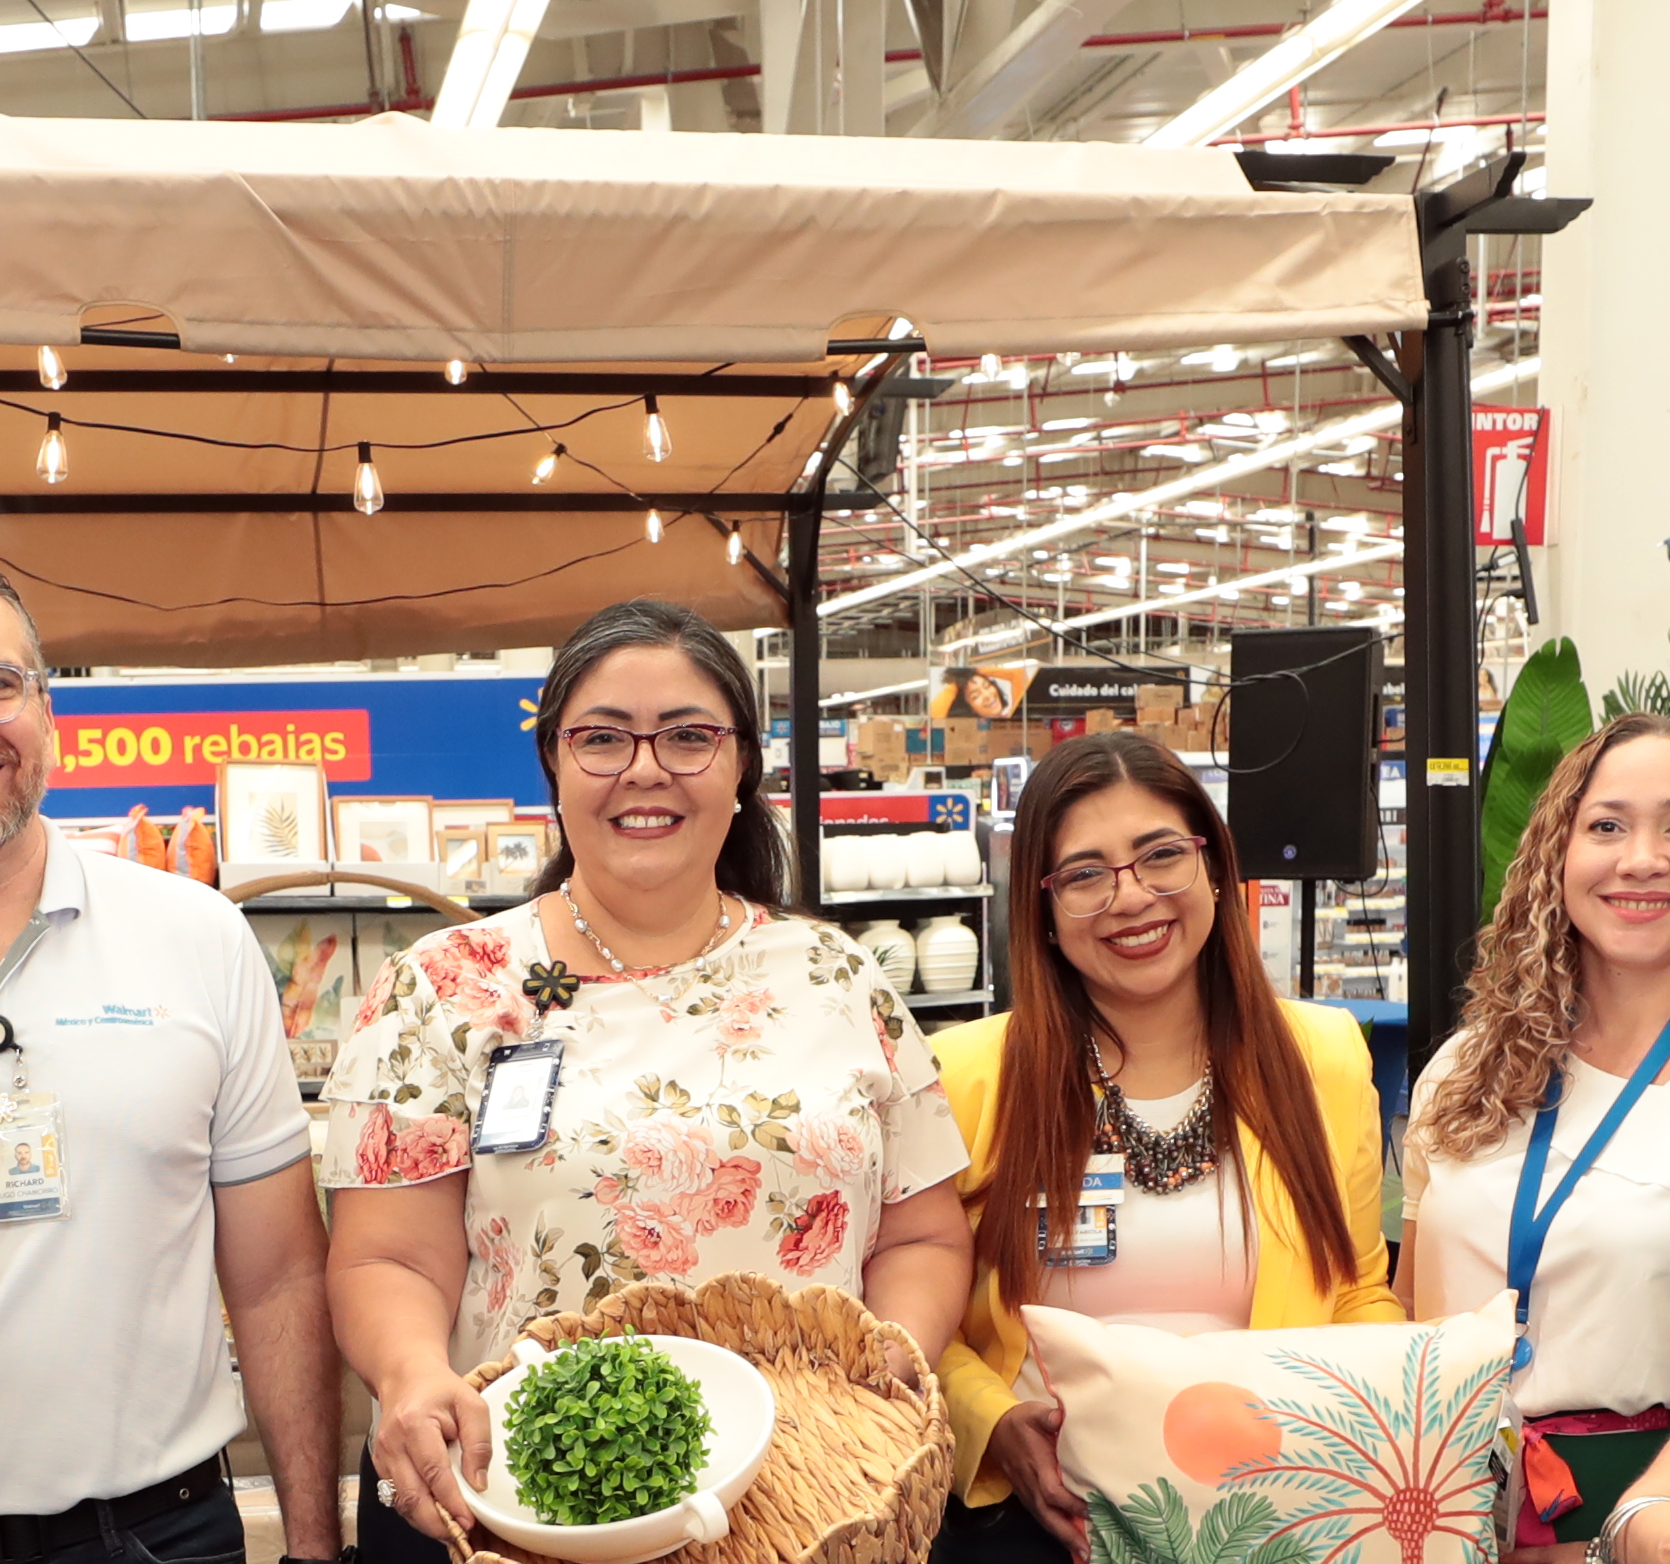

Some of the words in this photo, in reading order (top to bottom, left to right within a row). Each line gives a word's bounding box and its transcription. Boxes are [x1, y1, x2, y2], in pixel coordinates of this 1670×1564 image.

[1048, 683, 1099, 697] Cuidado
[1099, 683, 1119, 697] del
[102, 1005, 153, 1018] Walmart
[5, 1177, 45, 1189] RICHARD
